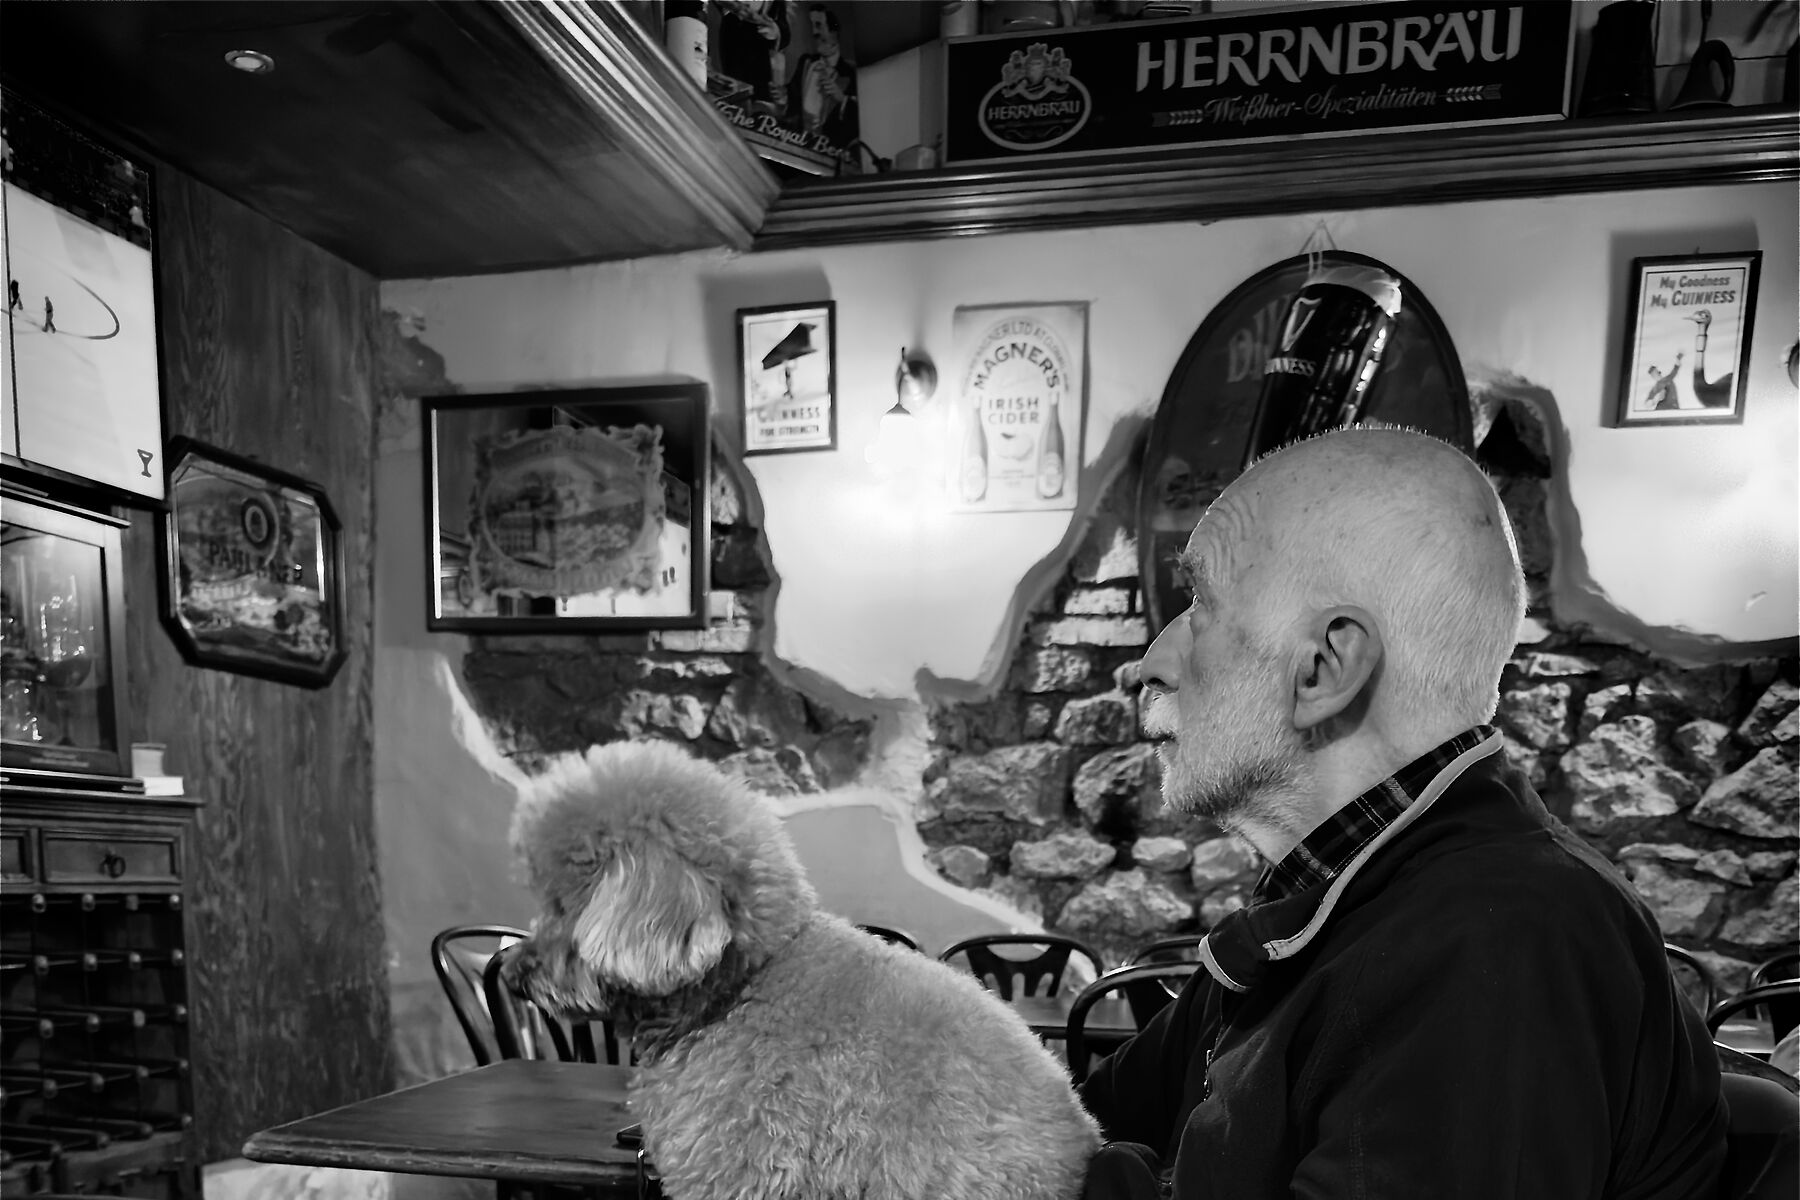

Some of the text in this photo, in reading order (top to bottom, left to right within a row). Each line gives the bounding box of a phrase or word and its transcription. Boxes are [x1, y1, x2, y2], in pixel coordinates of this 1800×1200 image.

[1136, 6, 1524, 92] HERRNBRÄU
[715, 101, 756, 128] The
[757, 114, 808, 147] Royal
[1659, 275, 1730, 290] My Goodness
[1651, 290, 1736, 308] My GUINNESS
[973, 342, 1060, 390] MAGNER'S
[989, 396, 1039, 411] IRISH
[988, 411, 1040, 425] CIDER
